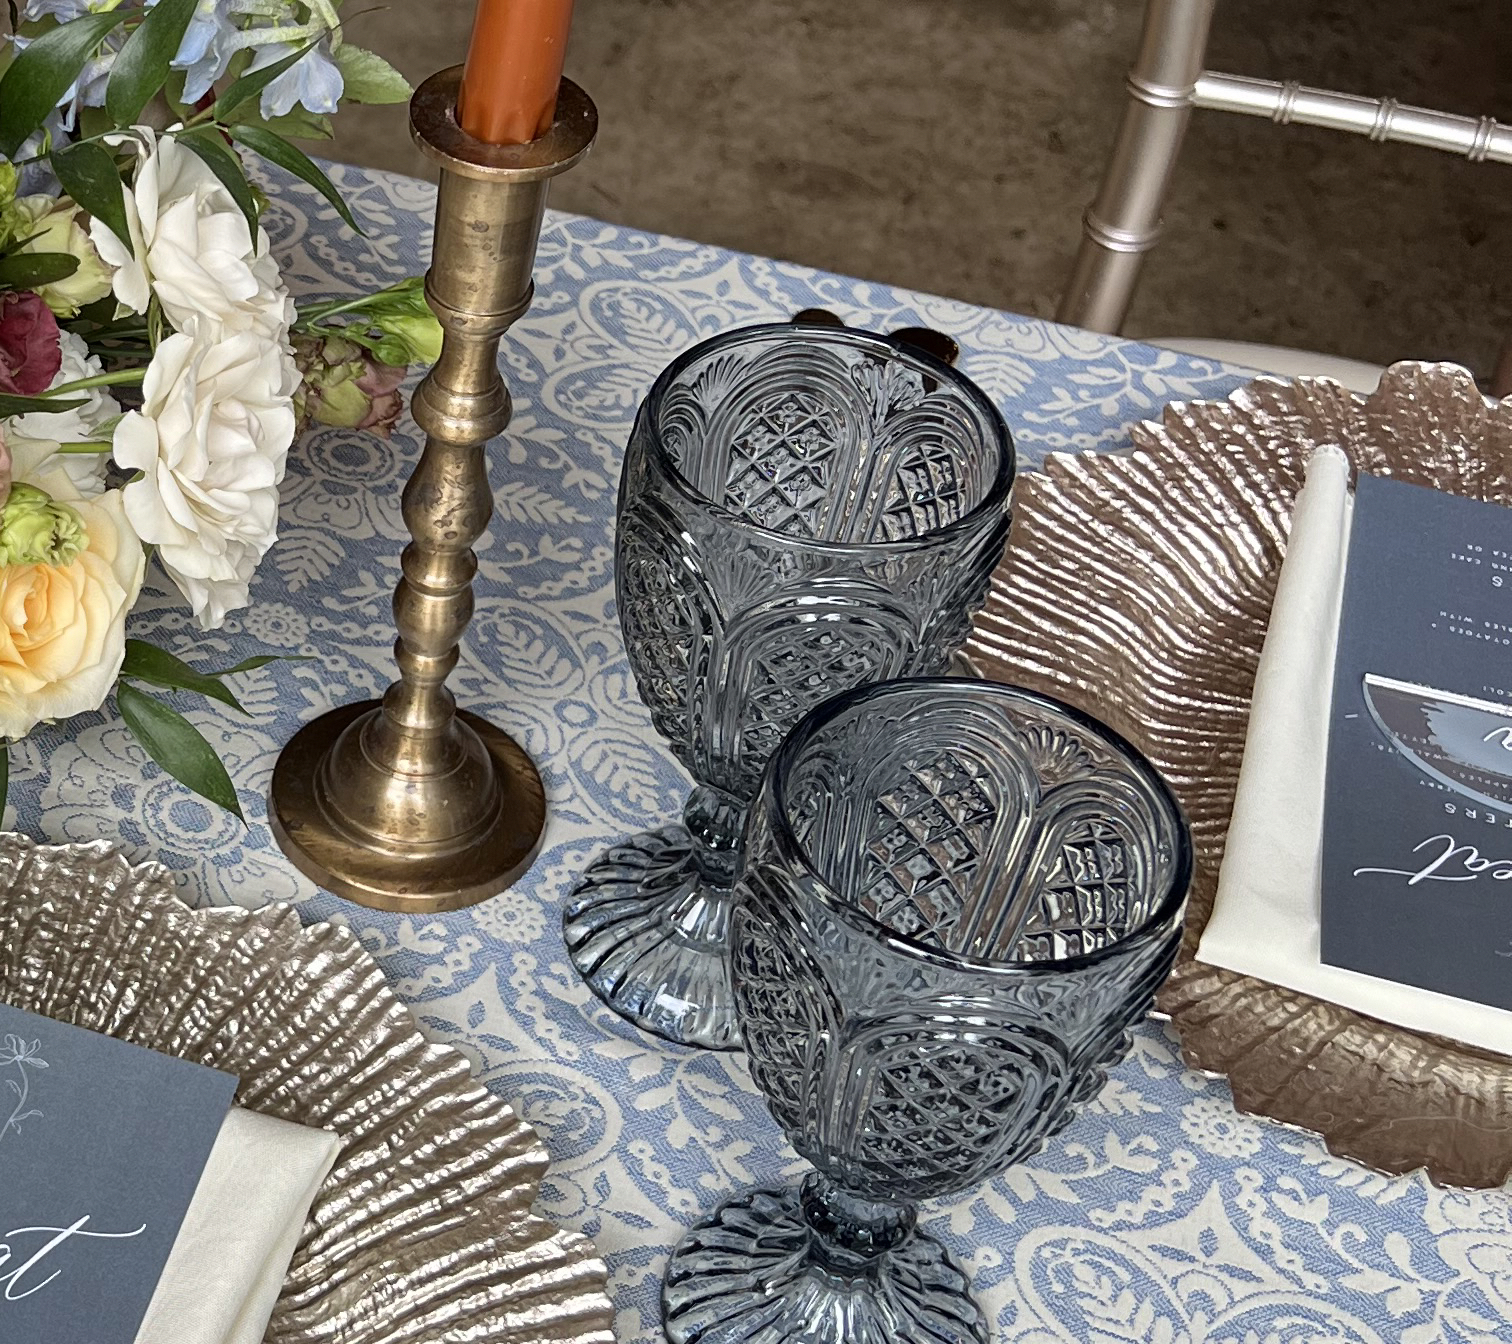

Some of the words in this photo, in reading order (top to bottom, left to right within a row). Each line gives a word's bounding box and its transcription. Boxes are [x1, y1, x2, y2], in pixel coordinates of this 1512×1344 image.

[1467, 543, 1483, 553] OR
[1451, 552, 1482, 565] CAKE
[1449, 624, 1511, 646] OTATOES
